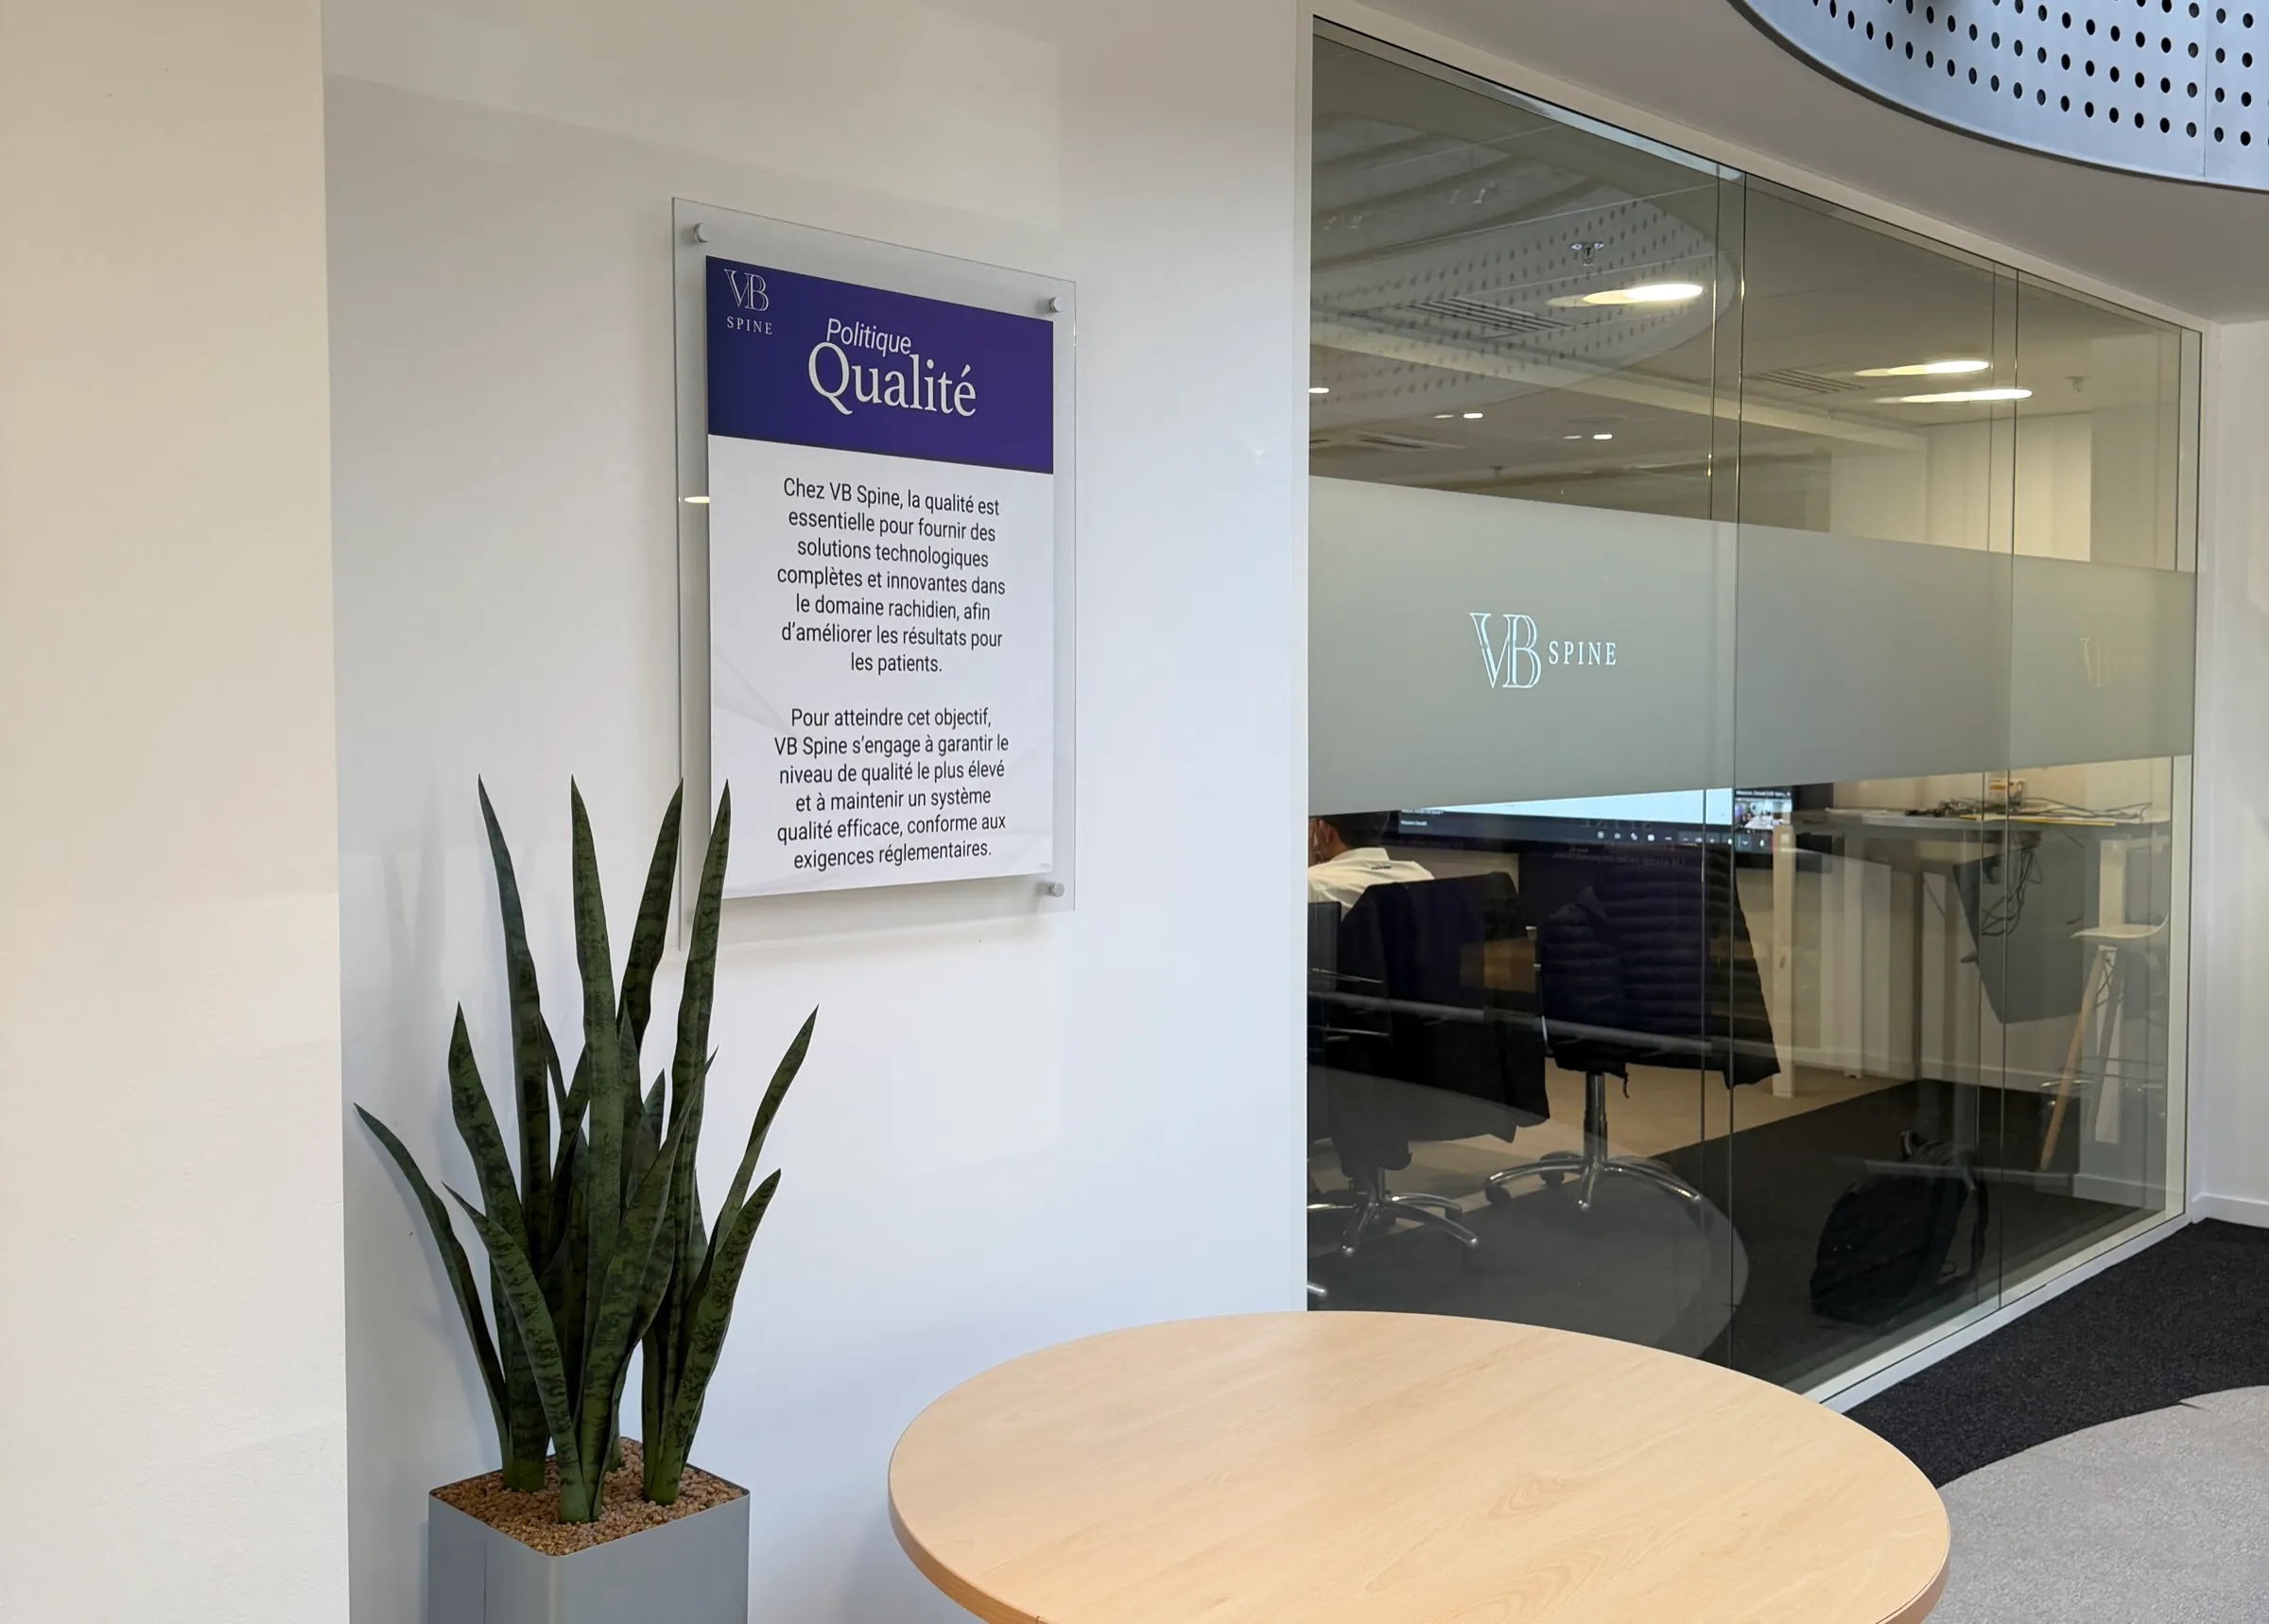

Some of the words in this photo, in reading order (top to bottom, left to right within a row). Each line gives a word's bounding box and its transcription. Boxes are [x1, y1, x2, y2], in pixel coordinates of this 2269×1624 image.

[724, 268, 770, 312] VB
[726, 316, 773, 336] SPINE
[826, 318, 911, 356] Politique
[808, 341, 977, 417] Qualité
[784, 477, 824, 499] Chez
[829, 482, 852, 501] VB
[857, 485, 903, 510] Spine,
[909, 489, 920, 508] la
[926, 493, 974, 513] qualité
[979, 500, 999, 515] est
[788, 511, 875, 531] essentielle
[880, 519, 913, 537] pour
[918, 518, 966, 539] fournir
[971, 523, 996, 542] des
[798, 537, 871, 560] solutions
[875, 544, 988, 570] technologiques
[777, 566, 862, 589] complètes
[868, 572, 882, 588] et
[888, 571, 967, 593] innovantes
[972, 576, 1005, 595] dans
[797, 594, 809, 613] le
[815, 595, 884, 615] domaine
[889, 599, 959, 621] rachidien,
[964, 602, 990, 620] afin
[782, 622, 872, 643] d’améliorer
[877, 625, 898, 644] les
[904, 627, 966, 646] résultats
[972, 633, 1002, 650] pour
[1469, 613, 1542, 689] VB
[1549, 640, 1617, 665] SPINE
[852, 652, 873, 671] les
[878, 654, 942, 675] patients.
[792, 708, 829, 726] Pour
[835, 707, 903, 726] atteindre
[908, 710, 930, 725] cet
[935, 707, 991, 730] objectif,
[774, 737, 797, 755] VB
[803, 736, 847, 759] Spine
[853, 735, 920, 757] s’engage
[926, 734, 933, 752] à
[939, 734, 993, 756] garantir
[997, 734, 1009, 751] le
[780, 766, 832, 784] niveau
[838, 764, 857, 782] de
[862, 762, 912, 786] qualité
[918, 762, 929, 779] le
[935, 761, 963, 783] plus
[969, 759, 1004, 778] élevé
[796, 795, 811, 812] et
[817, 792, 824, 811] à
[831, 790, 904, 810] maintenir
[909, 793, 926, 806] un
[931, 786, 991, 810] système
[777, 820, 832, 846] qualité
[838, 819, 902, 838] efficace,
[908, 814, 977, 834] conforme
[982, 816, 1006, 830] aux
[794, 850, 874, 872] exigences
[879, 840, 991, 866] réglementaires.
